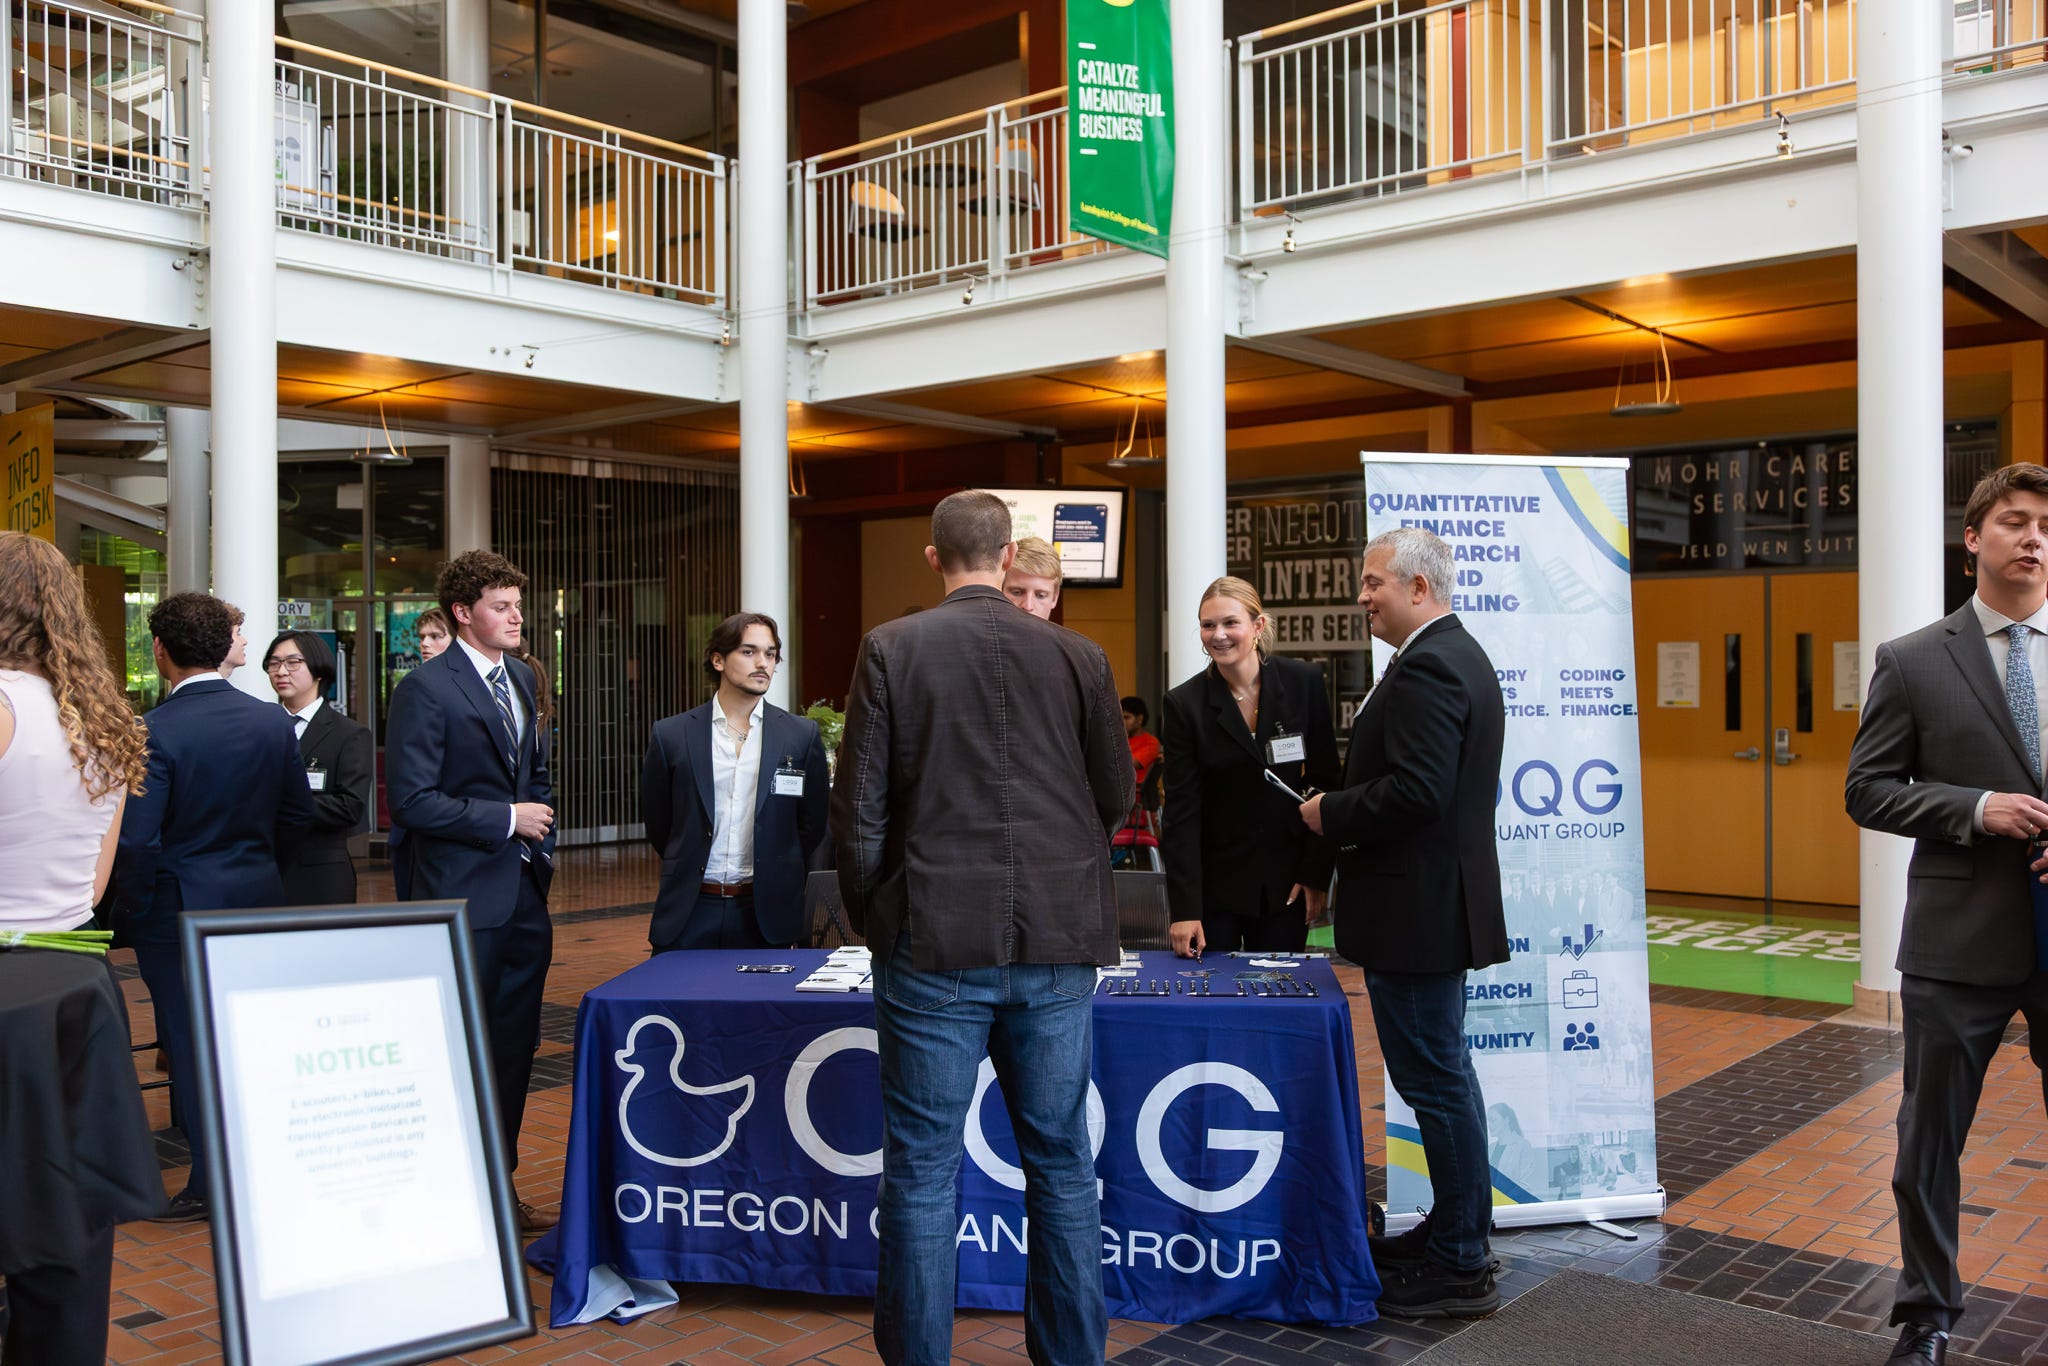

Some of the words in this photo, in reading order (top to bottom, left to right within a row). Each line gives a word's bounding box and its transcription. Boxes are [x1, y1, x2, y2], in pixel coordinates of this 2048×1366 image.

[1078, 59, 1139, 89] CATALYZE
[1079, 86, 1166, 118] MEANINGFUL
[1079, 113, 1144, 142] BUSINESS
[8, 446, 39, 500] INFO
[1655, 460, 1742, 485] MOHR
[1767, 451, 1851, 477] CARE
[1369, 493, 1541, 516] QUANTITATIVE
[1693, 485, 1851, 514] SERVICES
[1263, 502, 1365, 547] NEGOT
[1451, 544, 1520, 562] ARCH
[1680, 543, 1727, 559] JELD
[1743, 540, 1788, 556] WEN
[1804, 536, 1855, 553] SUIT
[1560, 669, 1626, 682] CODING
[1561, 687, 1614, 699] MEETS
[1561, 704, 1638, 717] FINANCE.
[1496, 759, 1623, 816] QG
[1498, 824, 1550, 840] UANT
[1556, 822, 1625, 839] GROUP
[294, 1042, 402, 1078] NOTICE
[614, 1183, 848, 1239] OREGON
